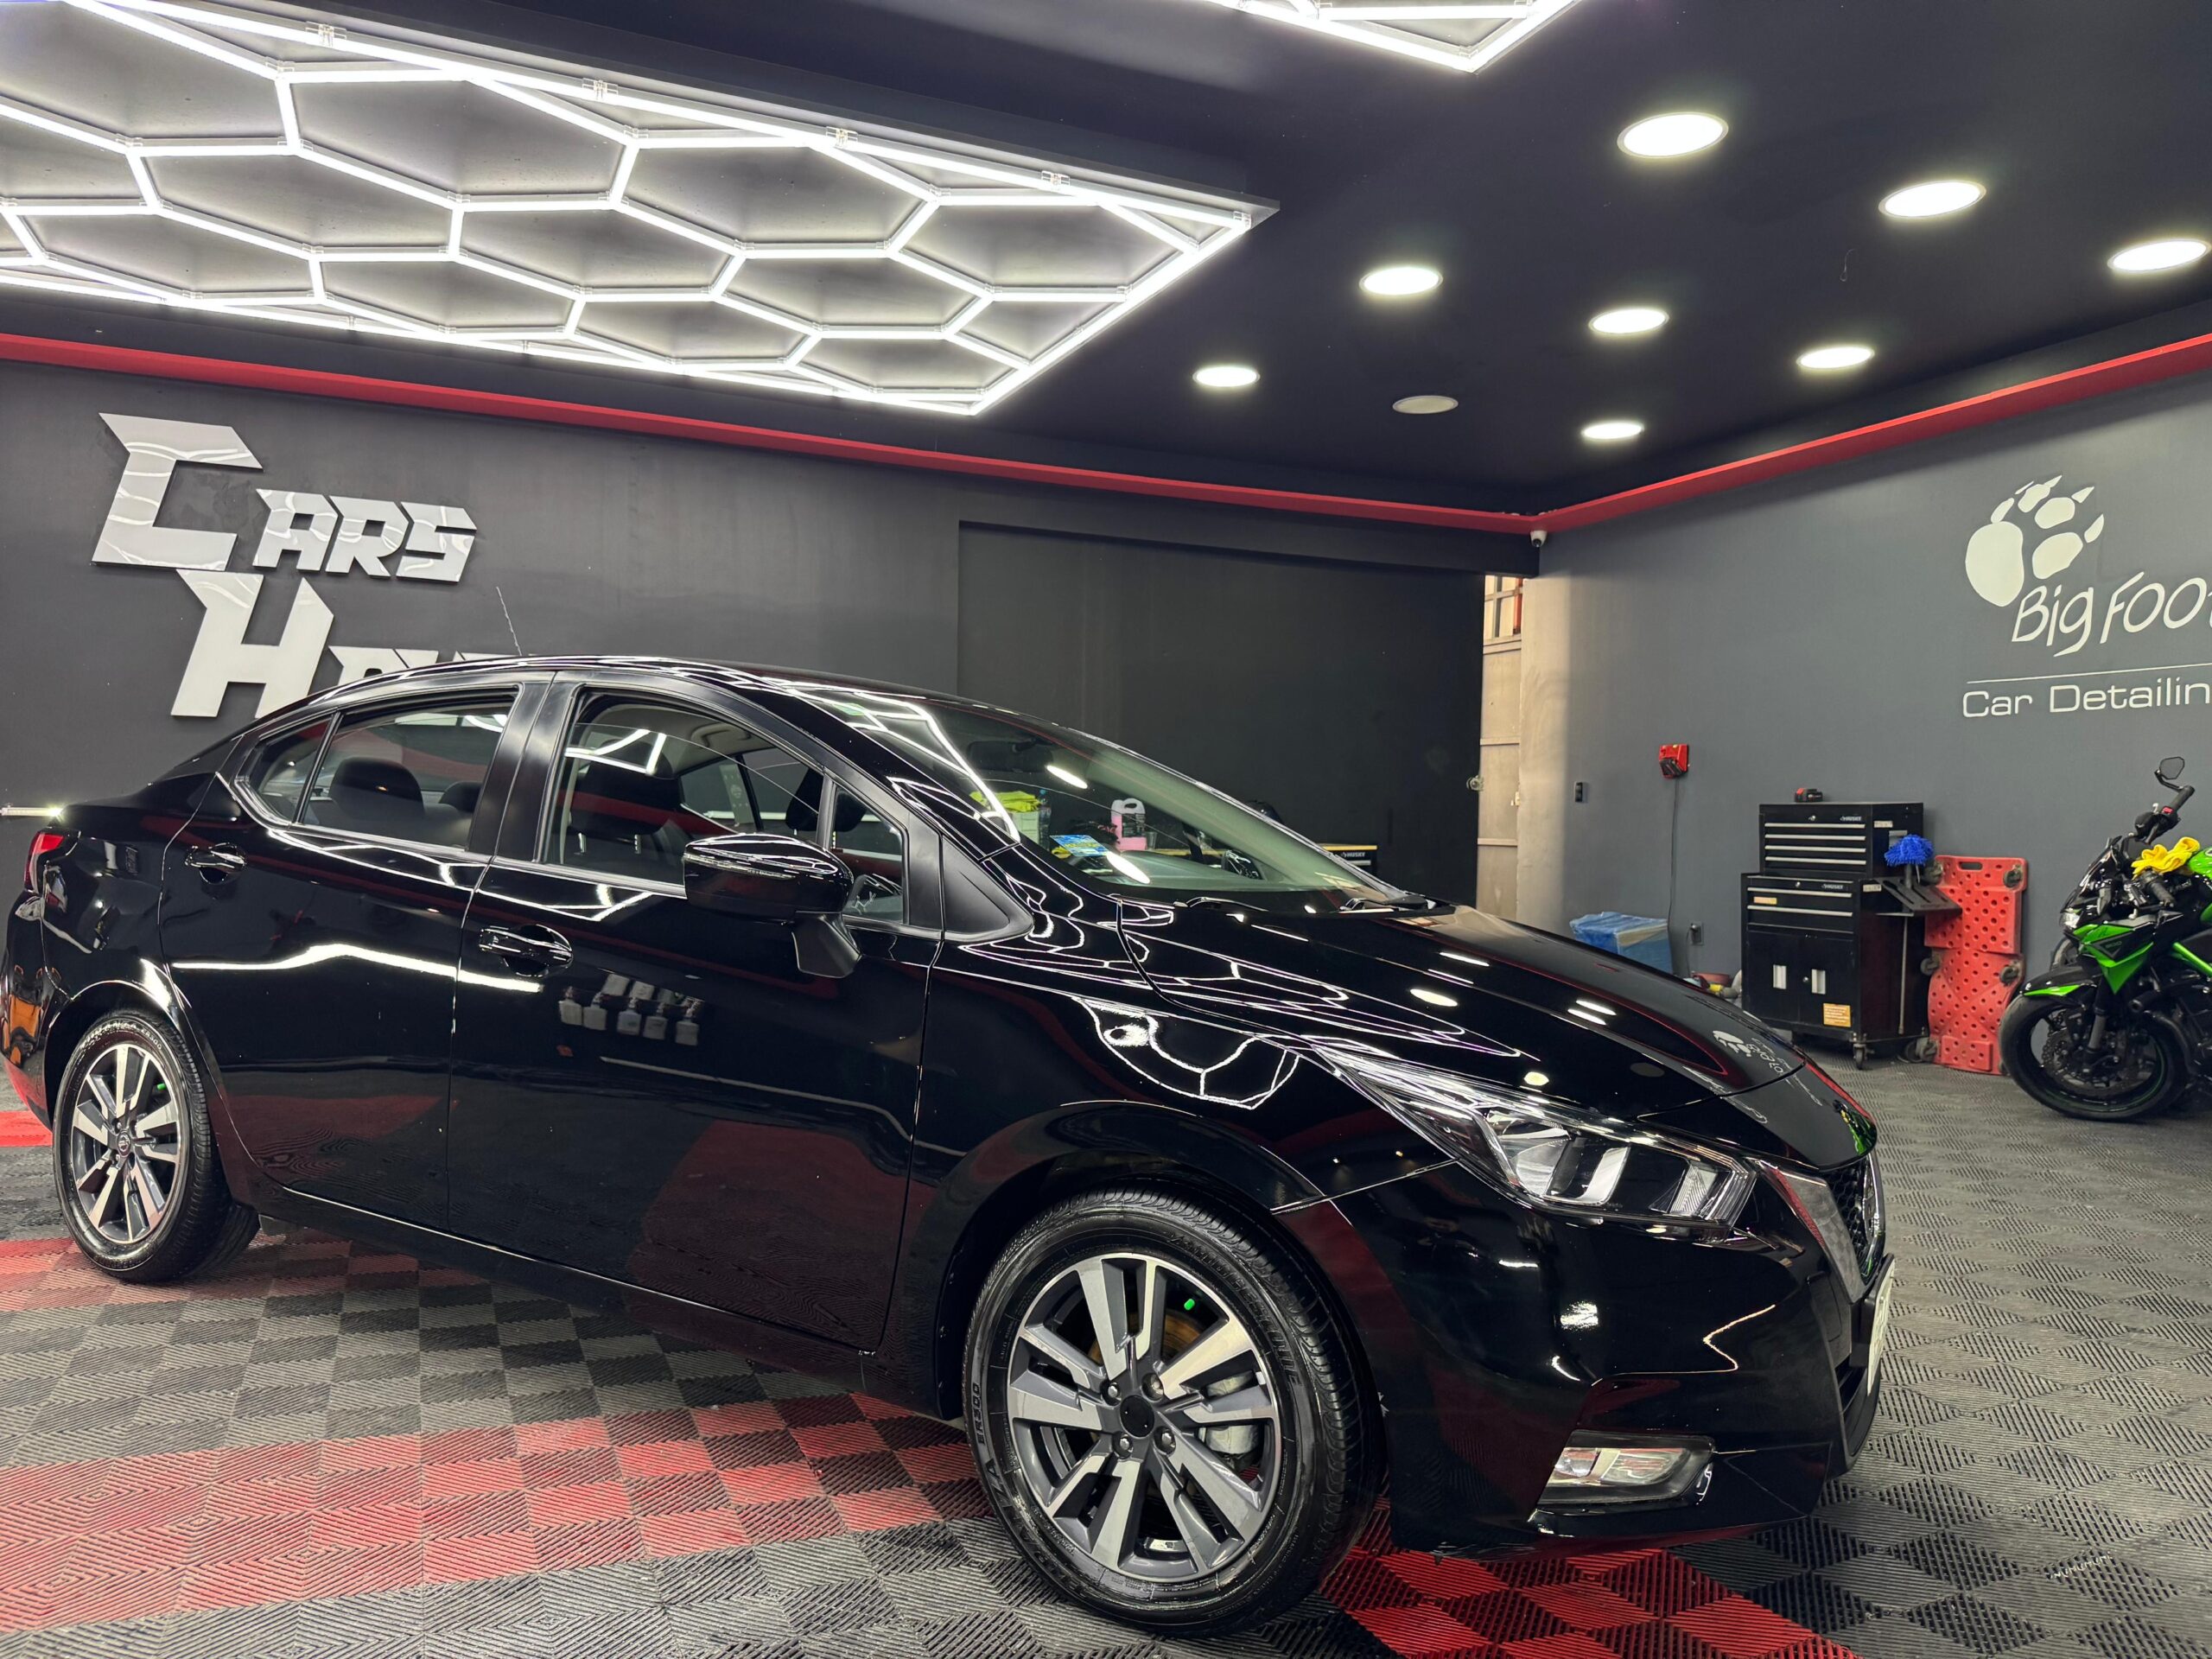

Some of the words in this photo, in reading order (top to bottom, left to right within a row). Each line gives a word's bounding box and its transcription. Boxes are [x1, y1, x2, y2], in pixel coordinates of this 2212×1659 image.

[92, 412, 477, 582] CARS
[2012, 584, 2094, 657] Big
[1962, 690, 2033, 717] Car
[2050, 676, 2210, 713] Detailin
[971, 1383, 986, 1446] ER300
